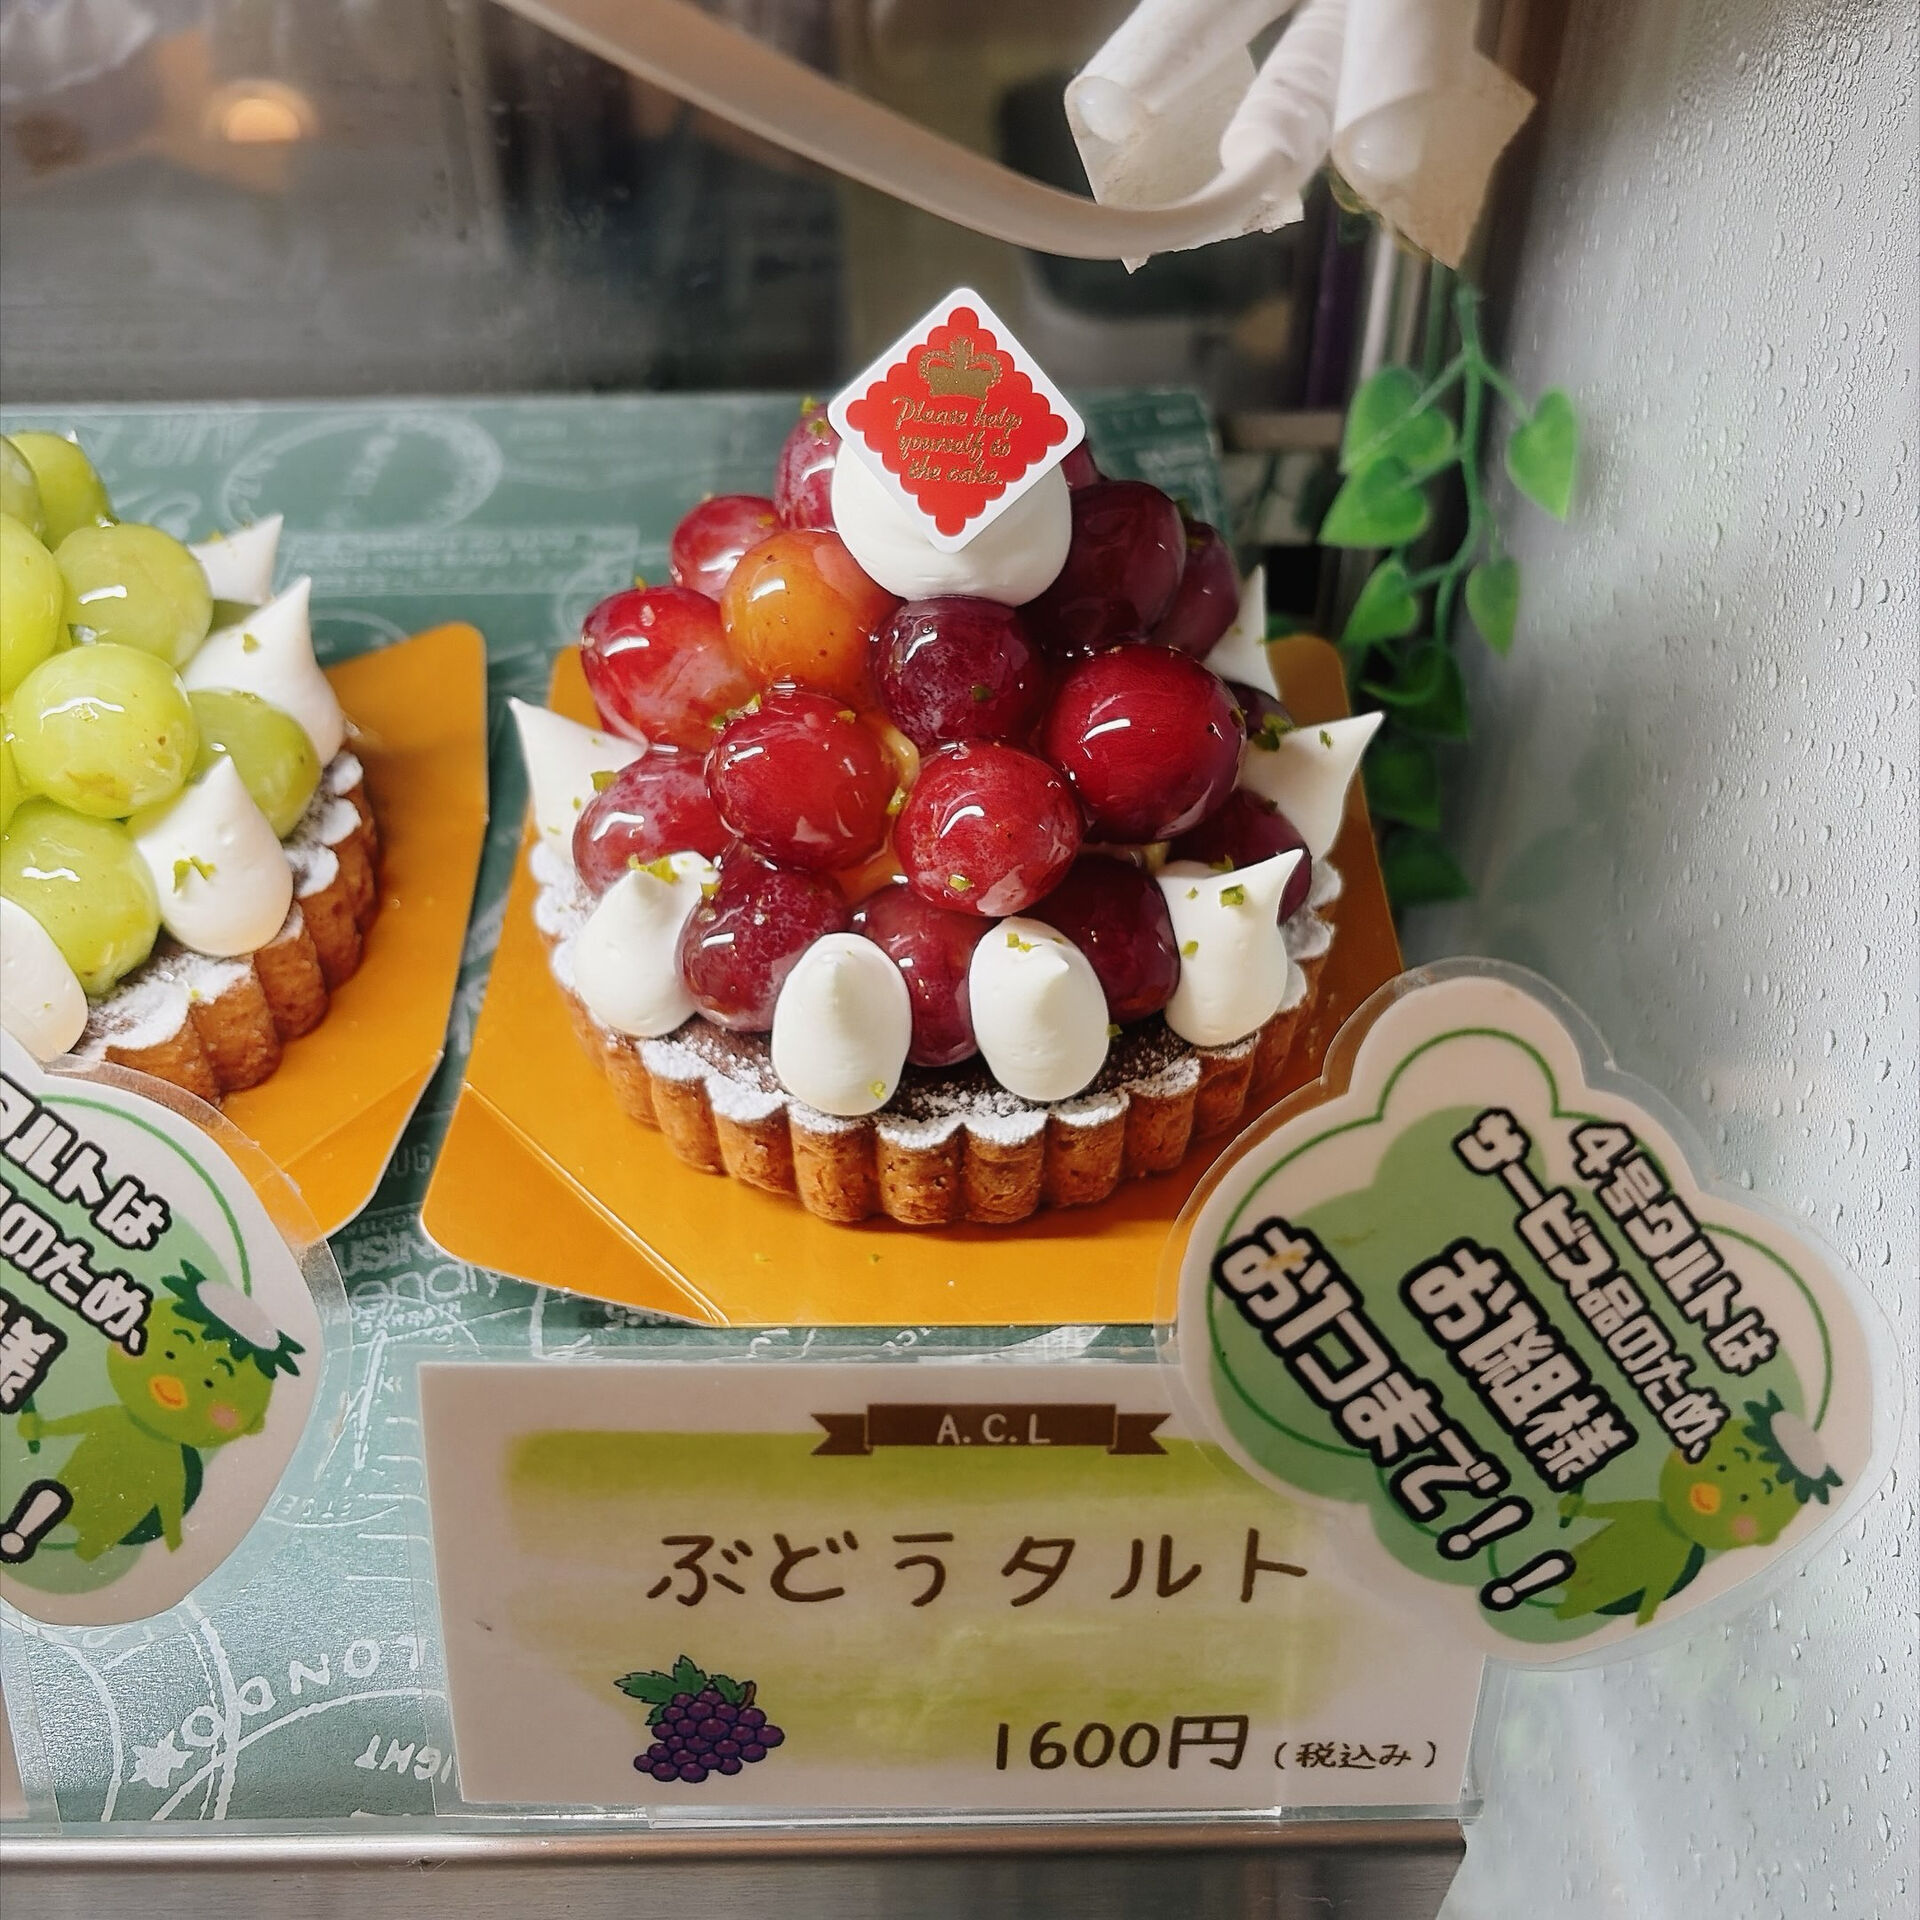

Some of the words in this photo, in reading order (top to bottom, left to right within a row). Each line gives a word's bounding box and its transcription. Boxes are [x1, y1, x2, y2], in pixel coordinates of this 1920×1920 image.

[892, 396, 967, 431] Please
[974, 400, 1022, 438] help
[899, 430, 985, 463] yourself
[990, 435, 1011, 457] to
[908, 455, 941, 481] the
[1569, 1120, 1780, 1375] 4号タルトは
[1450, 1105, 1730, 1464] サービス品のため、
[937, 1413, 1051, 1445] A.C.L
[647, 1527, 1309, 1609] ぶどうタルト
[995, 1714, 1251, 1772] 1600円
[1274, 1741, 1437, 1770] (税込み)
